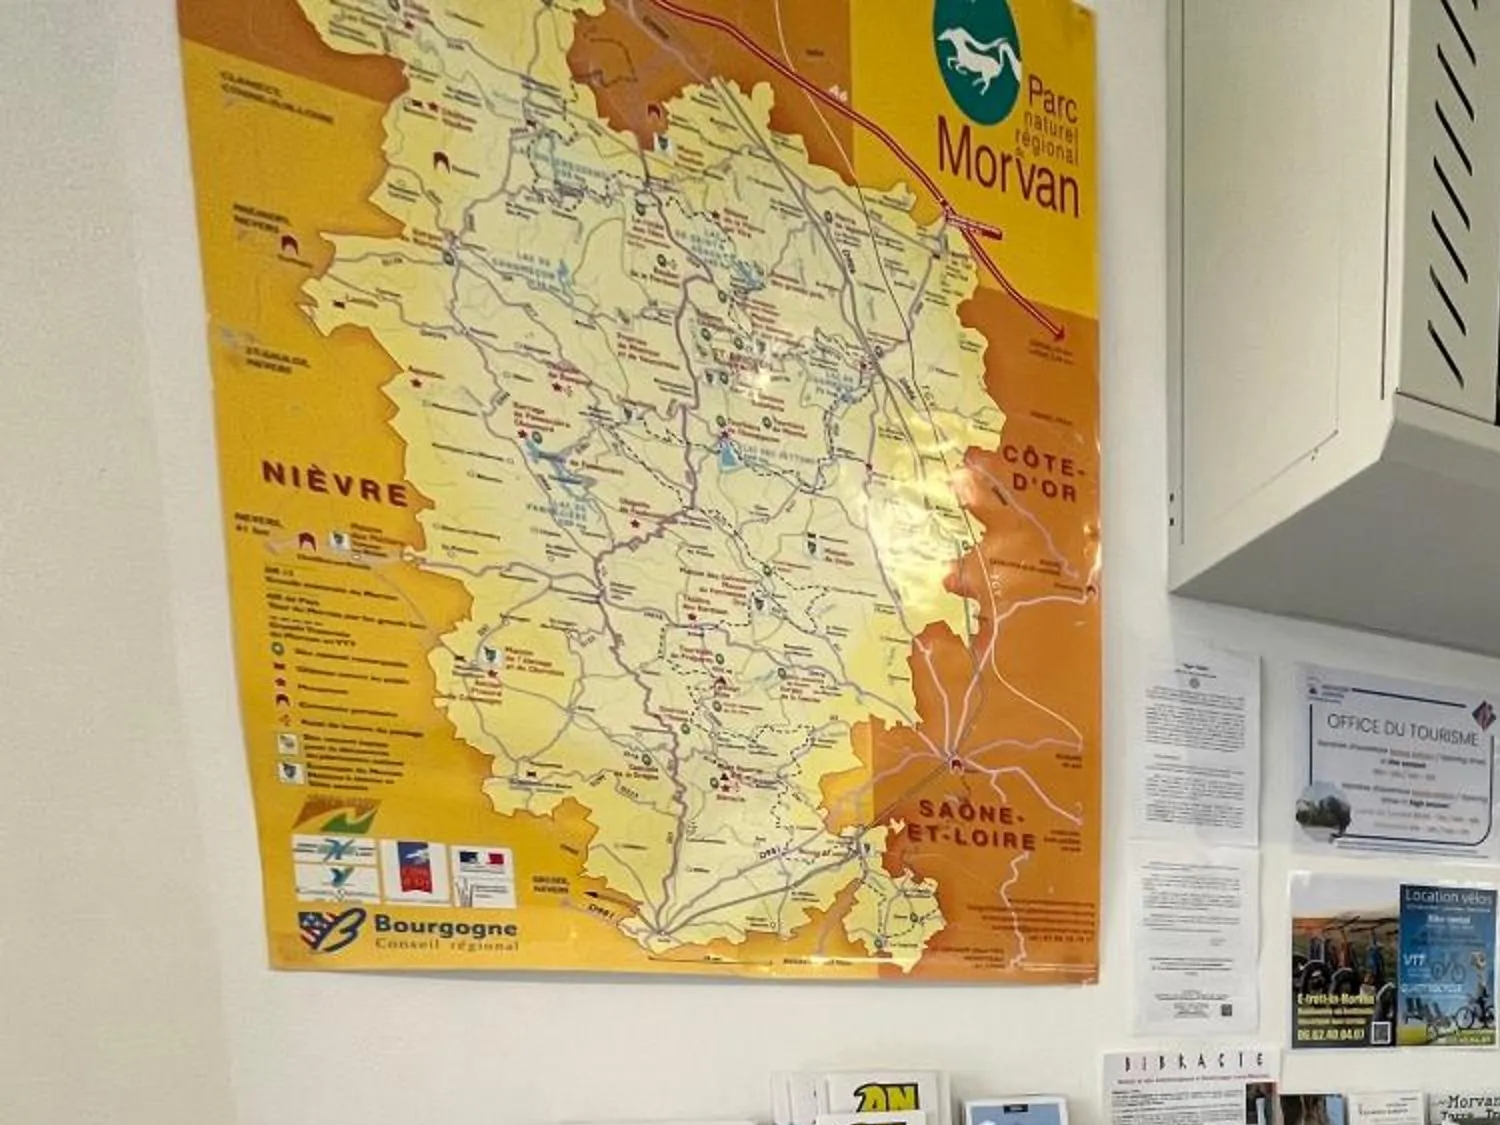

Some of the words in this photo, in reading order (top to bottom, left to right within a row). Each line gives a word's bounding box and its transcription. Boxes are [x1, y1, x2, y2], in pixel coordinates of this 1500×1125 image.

[1028, 75, 1078, 122] Parc
[1023, 110, 1079, 143] naturel
[1014, 129, 1079, 165] régional
[937, 116, 1080, 219] Morvan
[1002, 439, 1087, 477] CÔTE-
[262, 460, 408, 508] NIÈVRE
[1012, 473, 1078, 502] D'OR
[1327, 713, 1379, 735] OFFICE
[1385, 721, 1405, 738] DU
[1410, 722, 1480, 748] TOURISME
[919, 798, 1026, 824] SAÔNE-
[906, 824, 1038, 852] ET-LOIRE
[1405, 888, 1459, 904] Location
[374, 913, 518, 939] Bourgogne
[375, 939, 440, 951] Conseil
[450, 941, 519, 953] régional
